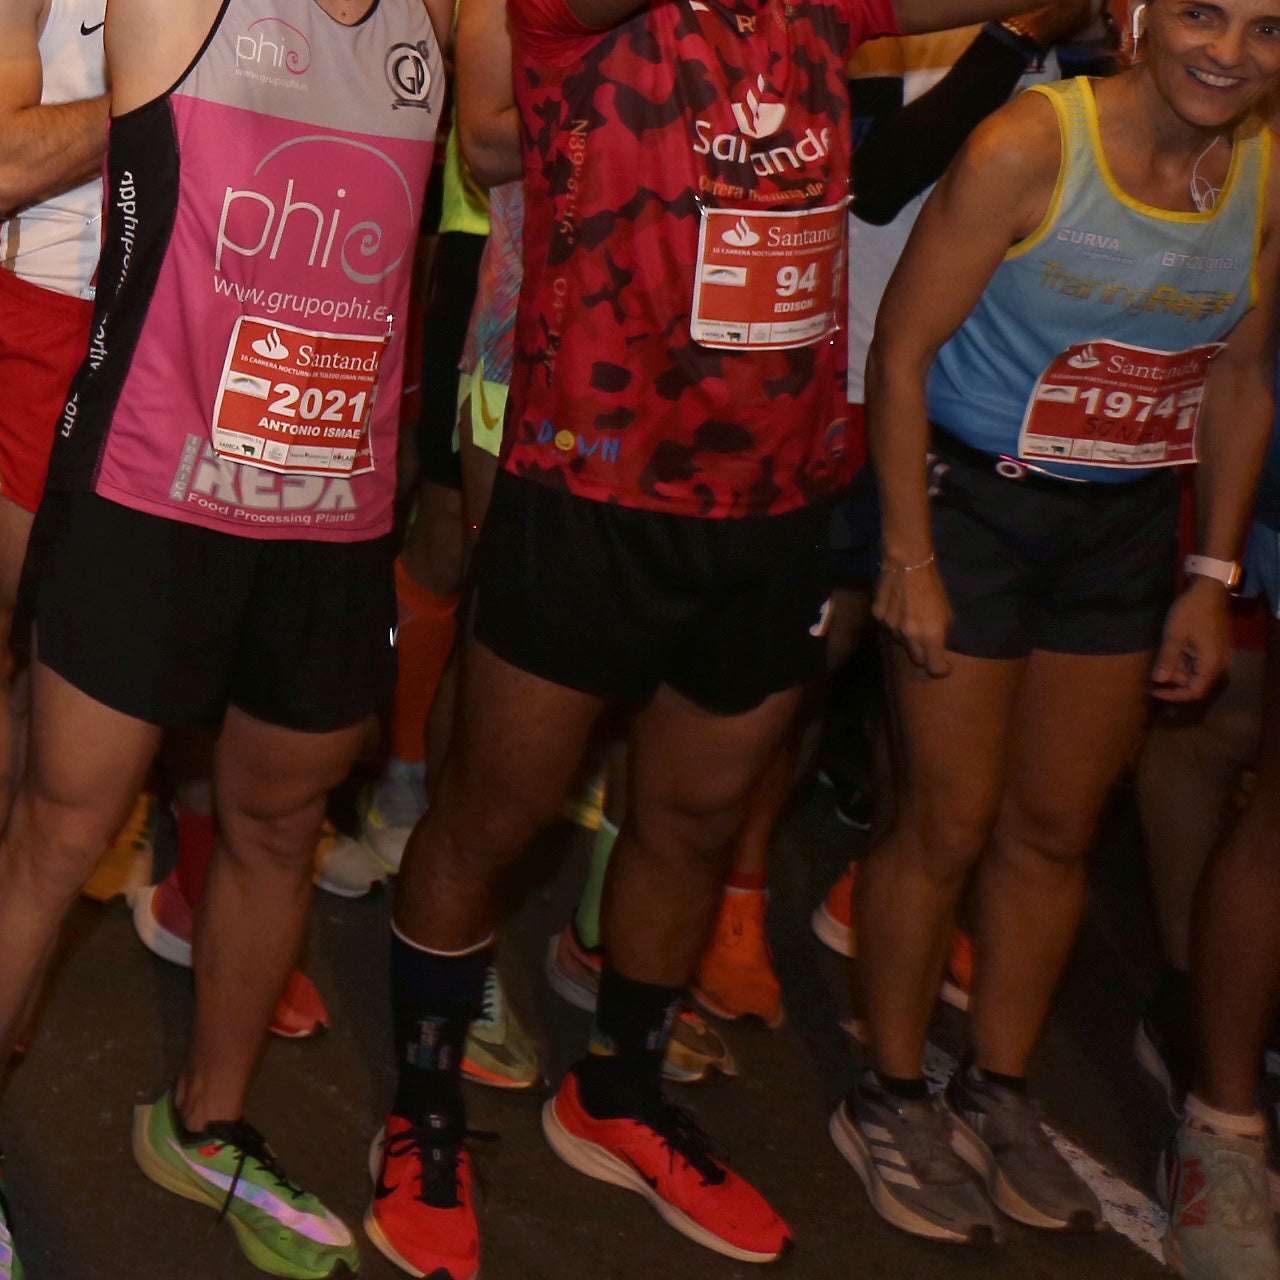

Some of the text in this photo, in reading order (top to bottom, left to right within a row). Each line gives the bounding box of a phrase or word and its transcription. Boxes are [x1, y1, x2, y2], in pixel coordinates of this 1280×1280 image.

[236, 33, 285, 68] phi
[215, 179, 346, 271] phi
[1057, 229, 1122, 251] CURVA
[775, 262, 818, 297] 94
[268, 382, 366, 423] 2021
[1080, 387, 1176, 422] 1974
[258, 417, 361, 439] ANTONIO ISMAE
[188, 492, 355, 525] Food Processing Plants
